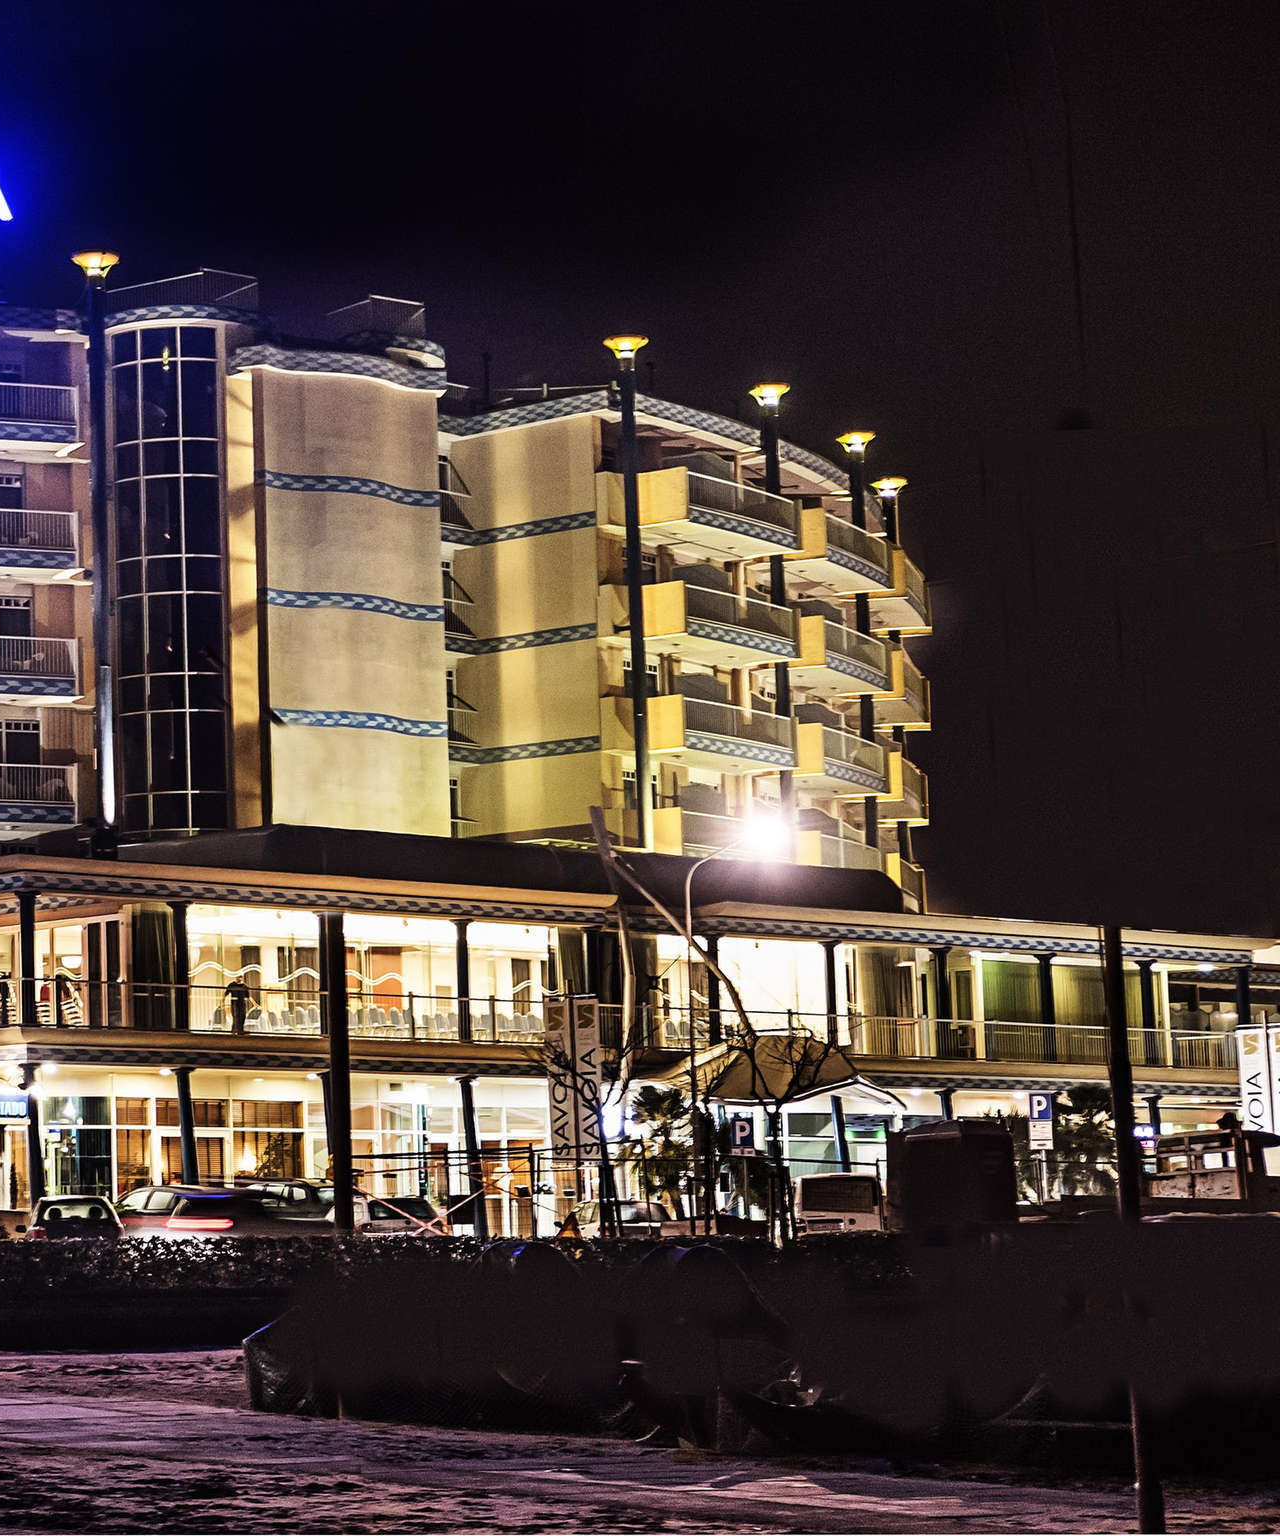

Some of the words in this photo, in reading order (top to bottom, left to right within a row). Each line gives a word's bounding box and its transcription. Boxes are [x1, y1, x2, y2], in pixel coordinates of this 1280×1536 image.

[551, 1050, 571, 1157] SAVOI
[580, 1047, 600, 1156] SAVOIA
[1032, 1095, 1047, 1118] P
[1246, 1072, 1265, 1131] VOIA
[735, 1121, 751, 1145] P
